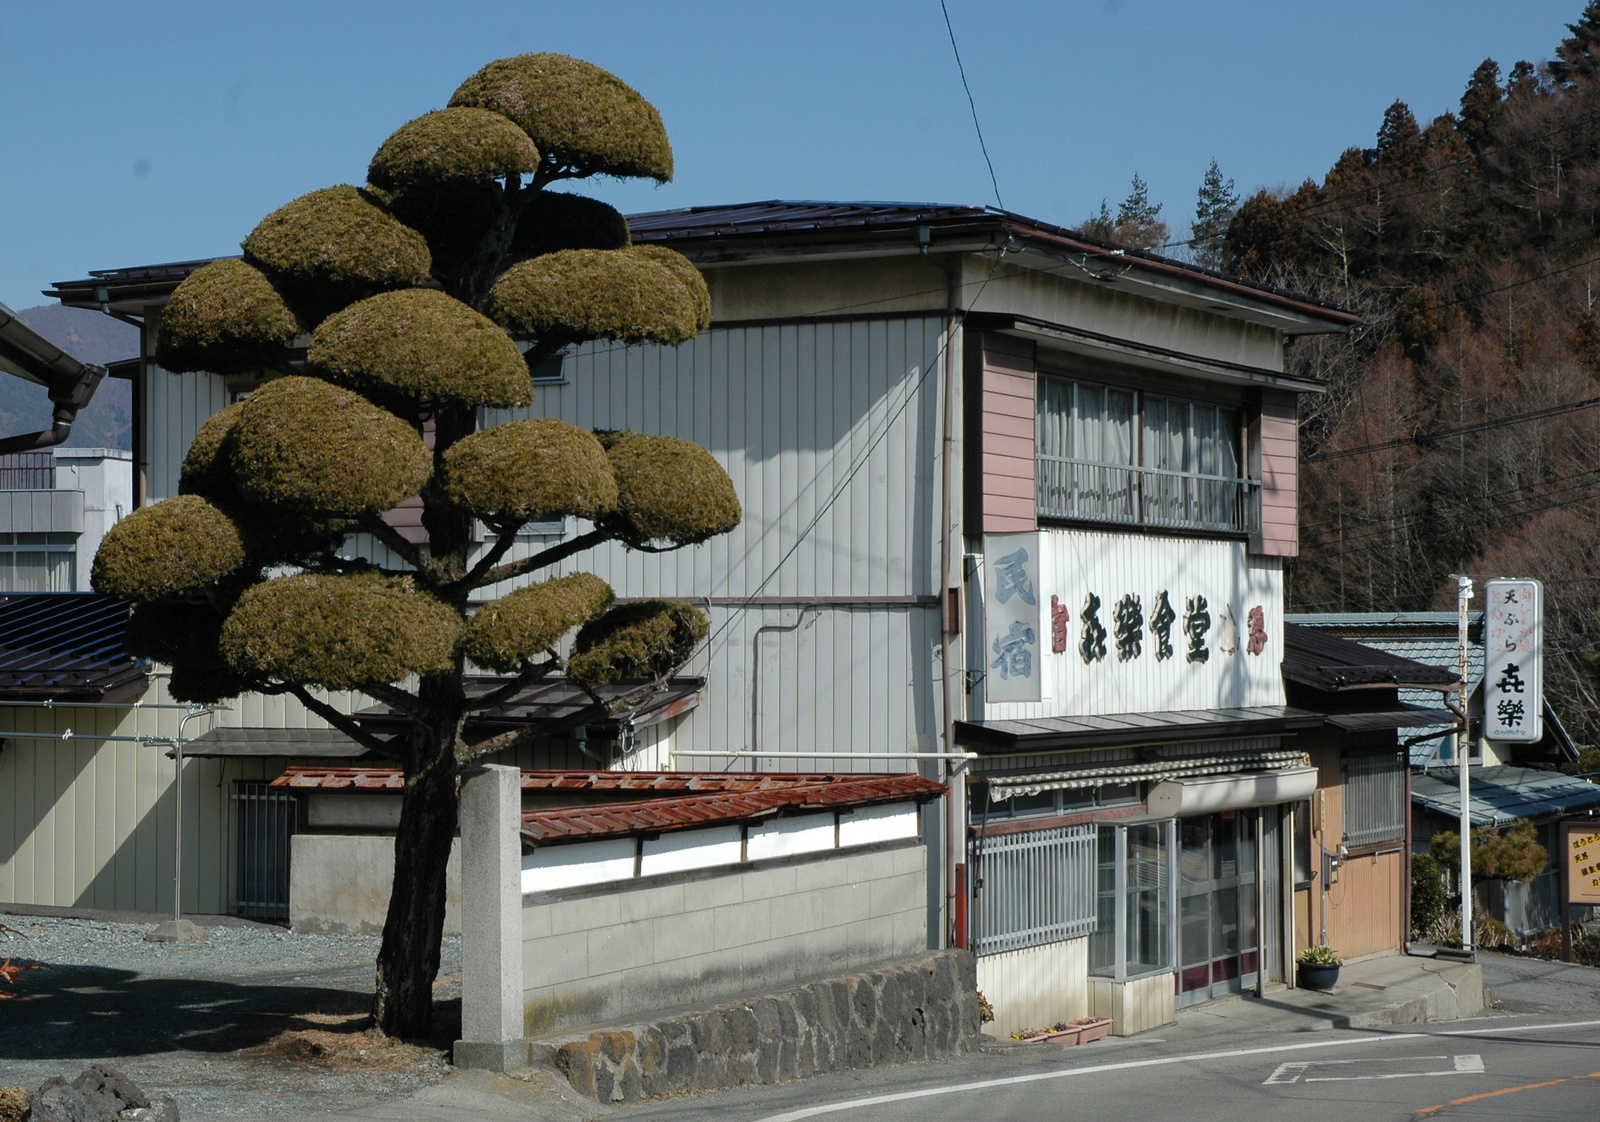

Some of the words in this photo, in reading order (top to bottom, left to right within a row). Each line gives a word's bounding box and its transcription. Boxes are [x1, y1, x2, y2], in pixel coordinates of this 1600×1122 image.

[990, 547, 1036, 681] 民宿
[1504, 588, 1519, 652] 天ぷら
